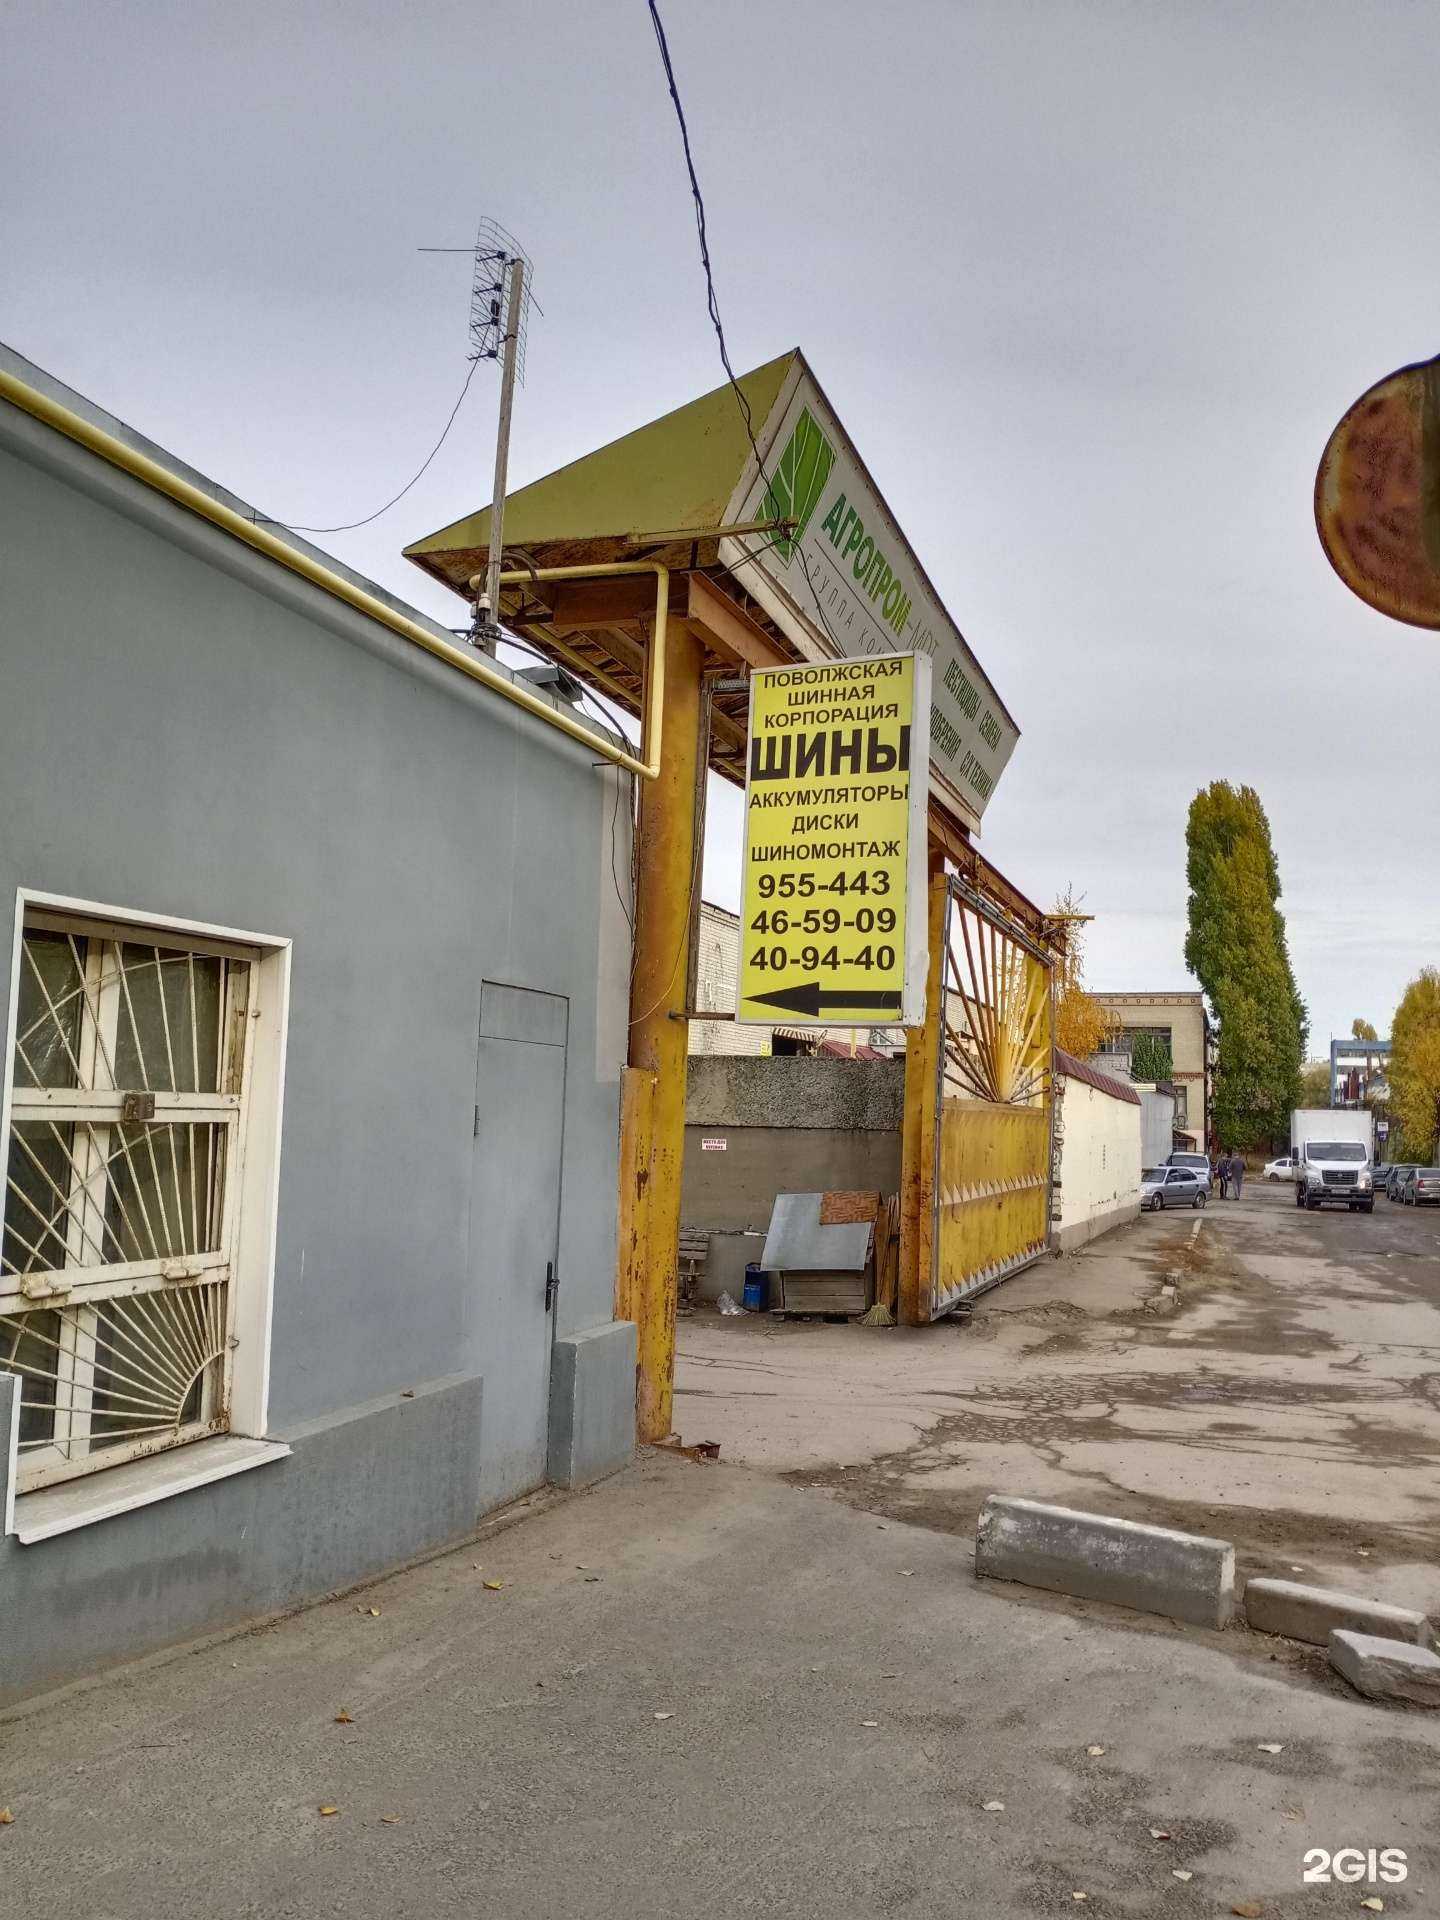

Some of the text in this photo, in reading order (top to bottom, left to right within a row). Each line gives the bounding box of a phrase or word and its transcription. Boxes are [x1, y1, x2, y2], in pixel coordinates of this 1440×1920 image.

[803, 553, 855, 630] ГРУППА
[764, 661, 902, 688] ПОВОЛЖСКАЯ
[788, 684, 875, 706] ШИННАЯ
[943, 658, 982, 721] ПЕСТИЦИДЫ
[765, 703, 898, 728] КОРПОРАЦИЯ
[750, 725, 911, 781] ШИНЫ
[750, 784, 909, 808] АККУМУЛЯТОРЫ
[792, 813, 859, 835] ДИСКИ
[752, 840, 900, 861] ШИНОМОНТАЖ
[758, 870, 890, 898] 955-443
[751, 908, 896, 934] 46-59-09
[750, 945, 895, 971] 40-94-40
